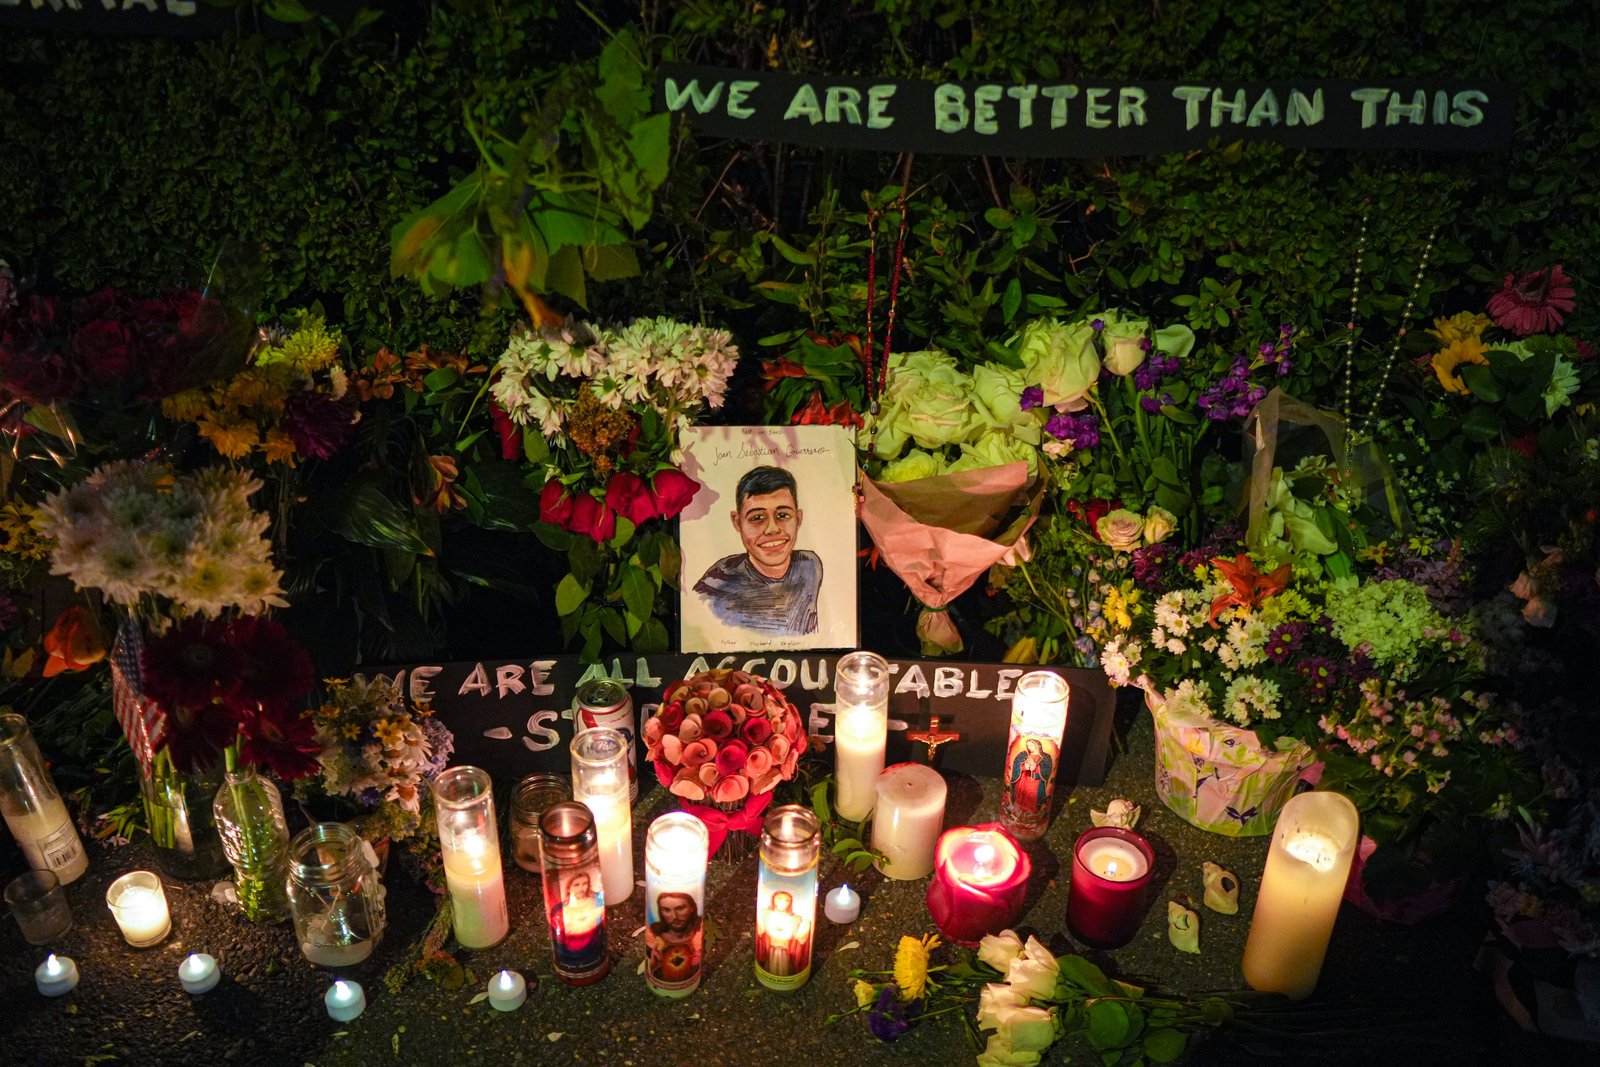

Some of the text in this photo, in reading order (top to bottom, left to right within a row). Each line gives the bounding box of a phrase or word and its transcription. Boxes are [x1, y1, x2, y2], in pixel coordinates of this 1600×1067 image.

[664, 77, 1489, 135] WE ARE BETTER THAN THIS
[457, 660, 557, 699] ARE
[575, 657, 662, 688] ALL
[683, 656, 1022, 700] ACOUABLE
